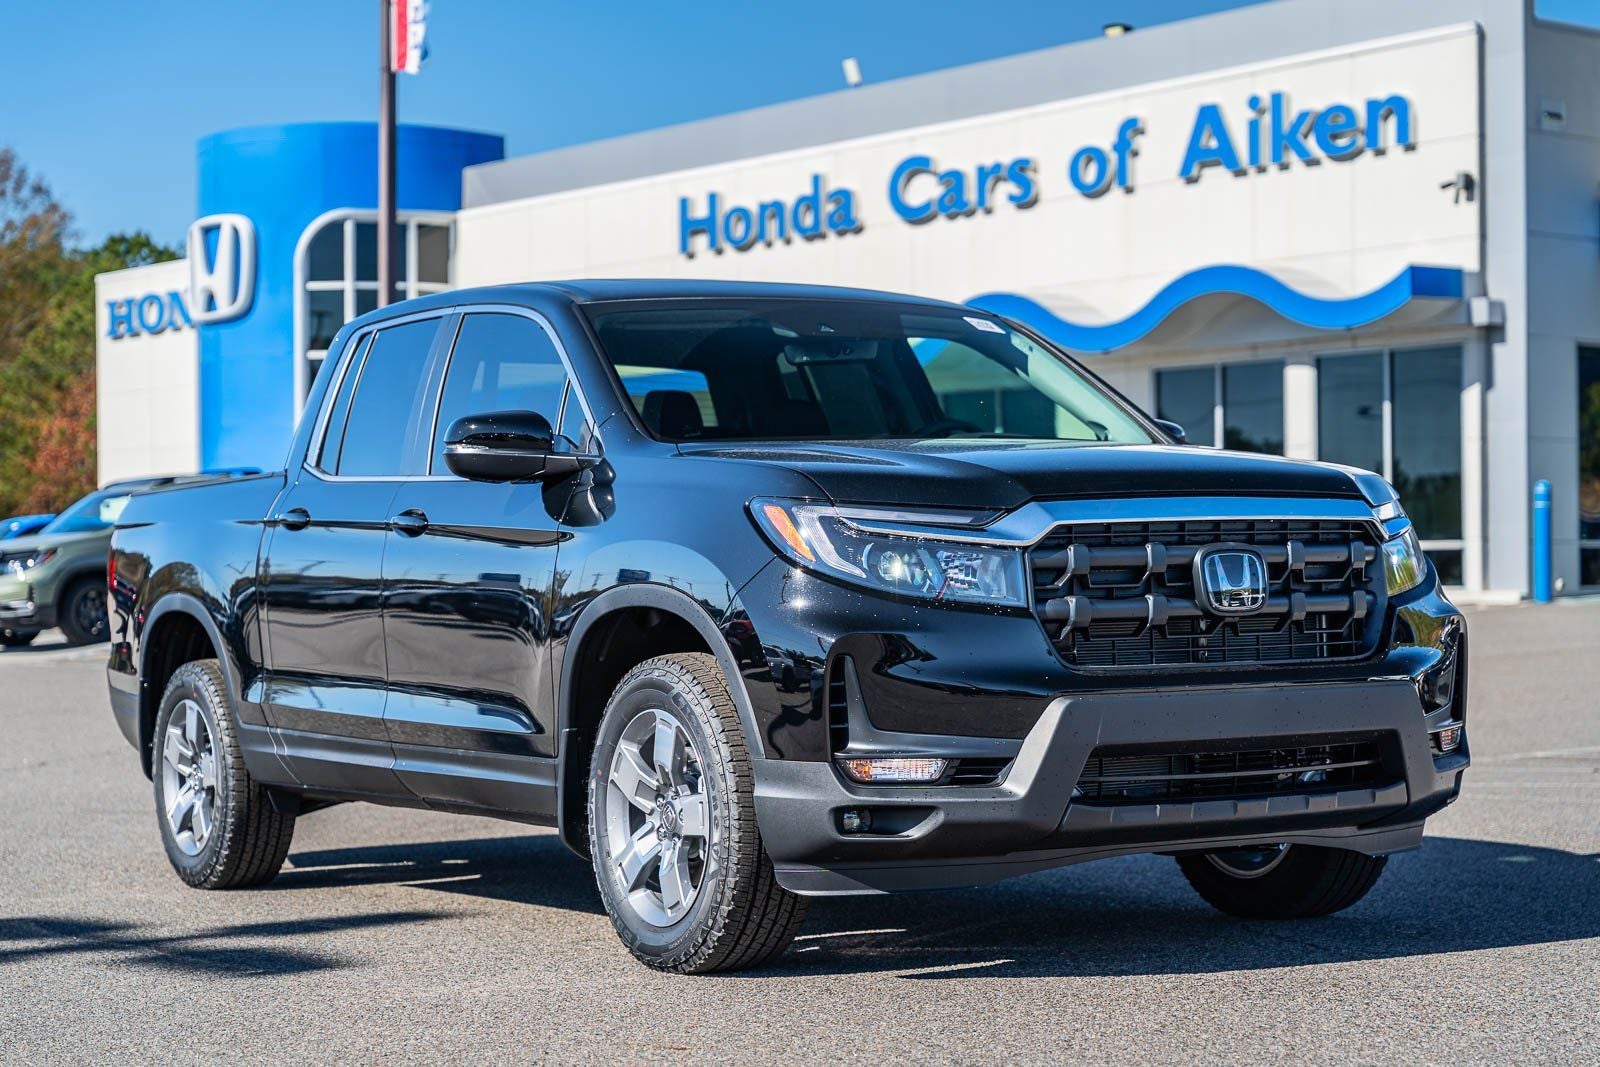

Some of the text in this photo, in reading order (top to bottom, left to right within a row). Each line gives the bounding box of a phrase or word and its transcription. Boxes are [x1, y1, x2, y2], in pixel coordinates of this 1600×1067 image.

[680, 92, 1414, 257] Honda Cars of Aiken
